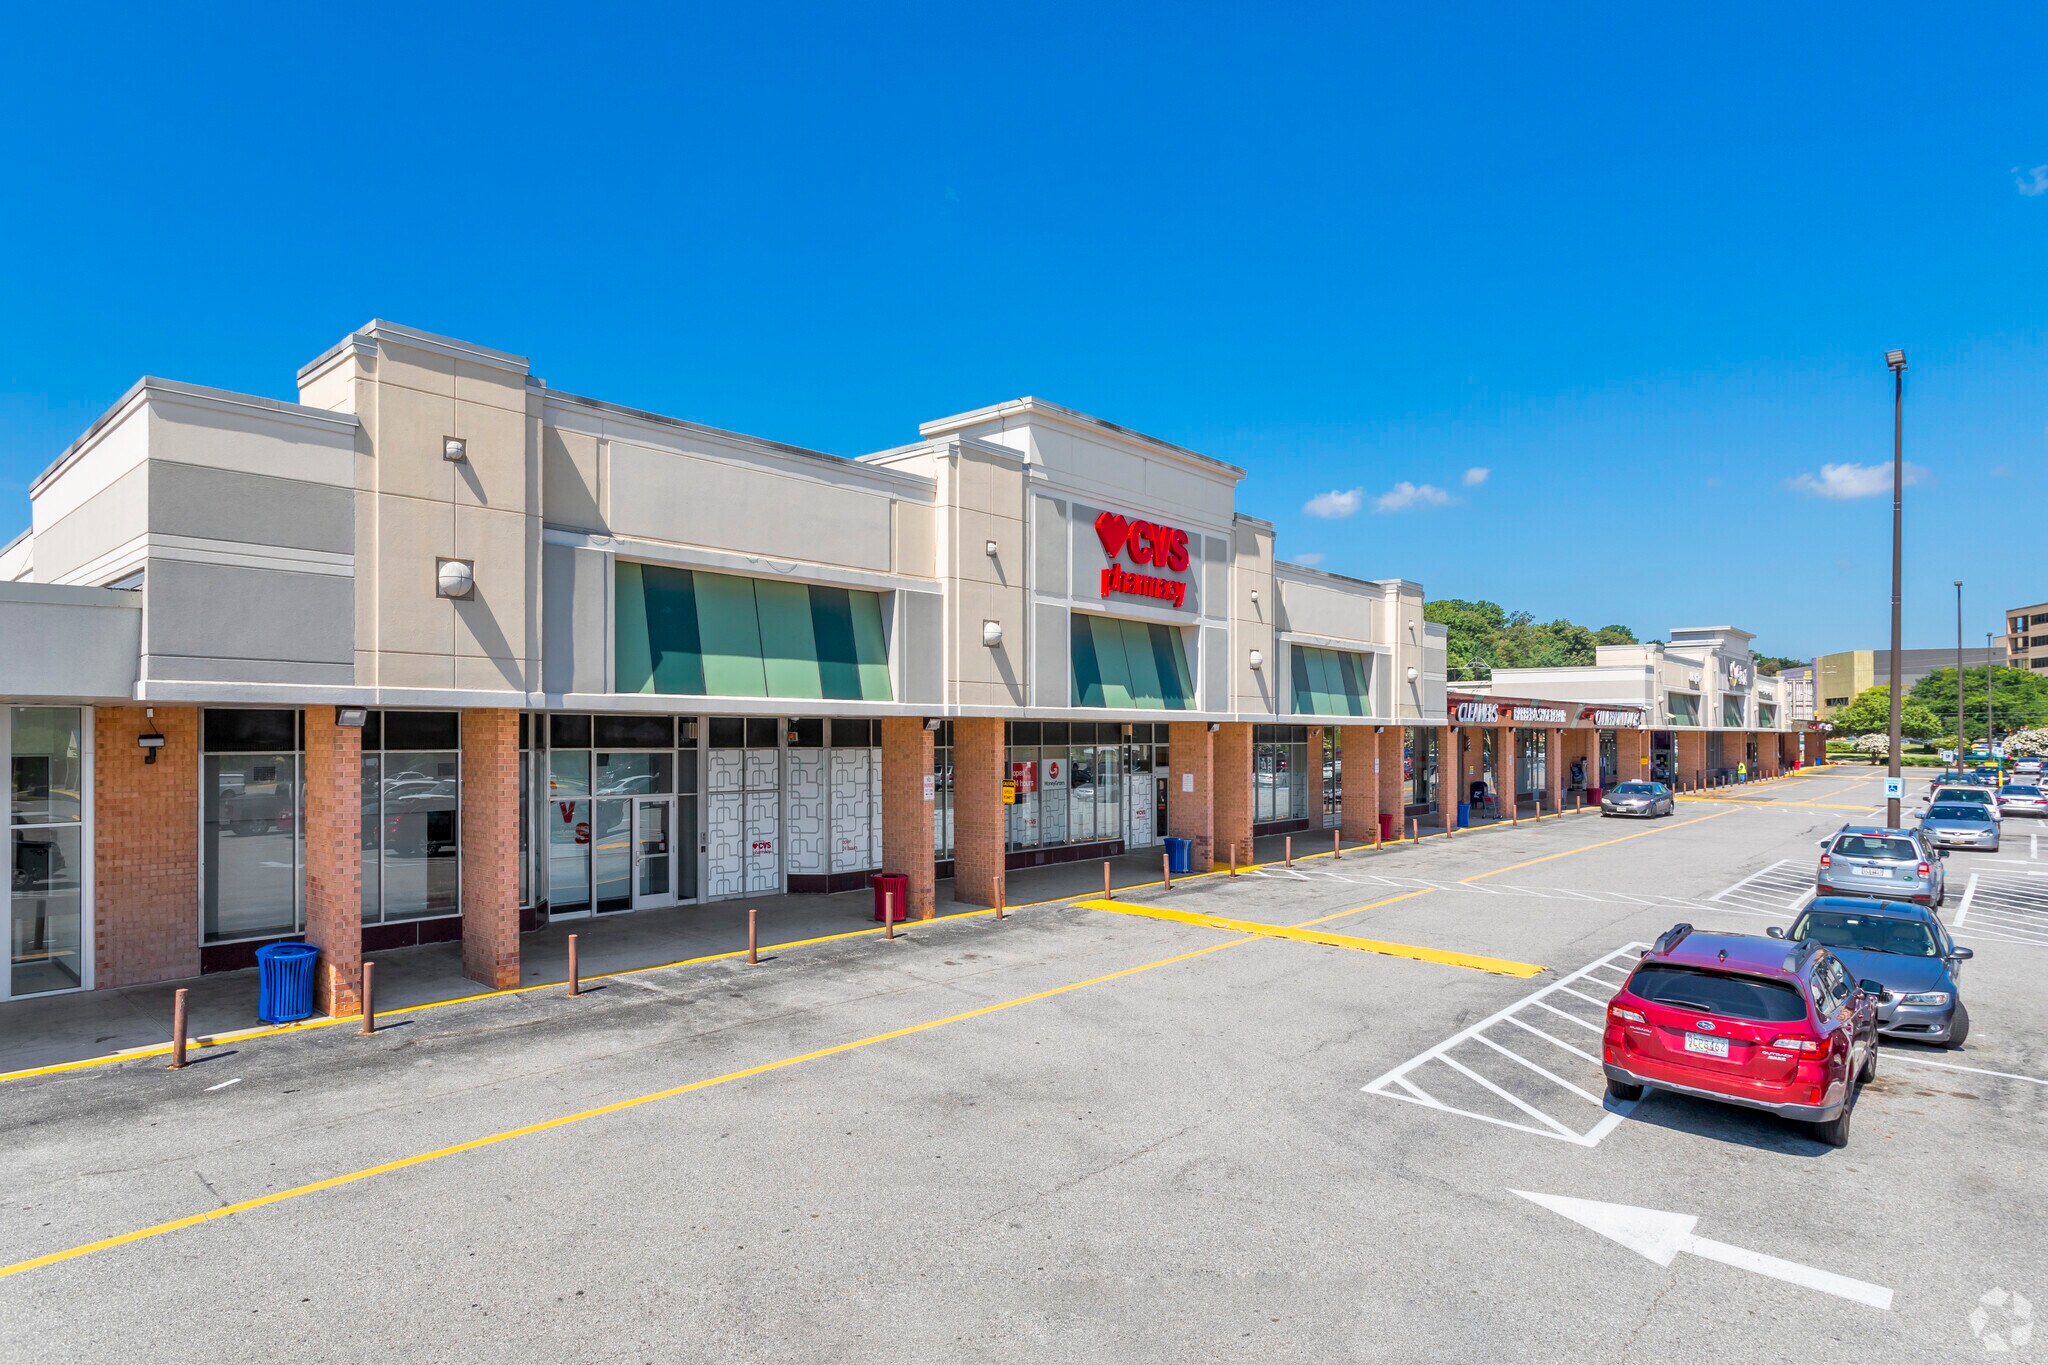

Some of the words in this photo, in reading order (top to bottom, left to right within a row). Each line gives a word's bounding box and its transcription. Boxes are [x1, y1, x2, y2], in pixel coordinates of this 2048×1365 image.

[1126, 520, 1190, 572] CVS
[1100, 563, 1187, 608] pharmacy
[1457, 703, 1499, 722] CLEANERS
